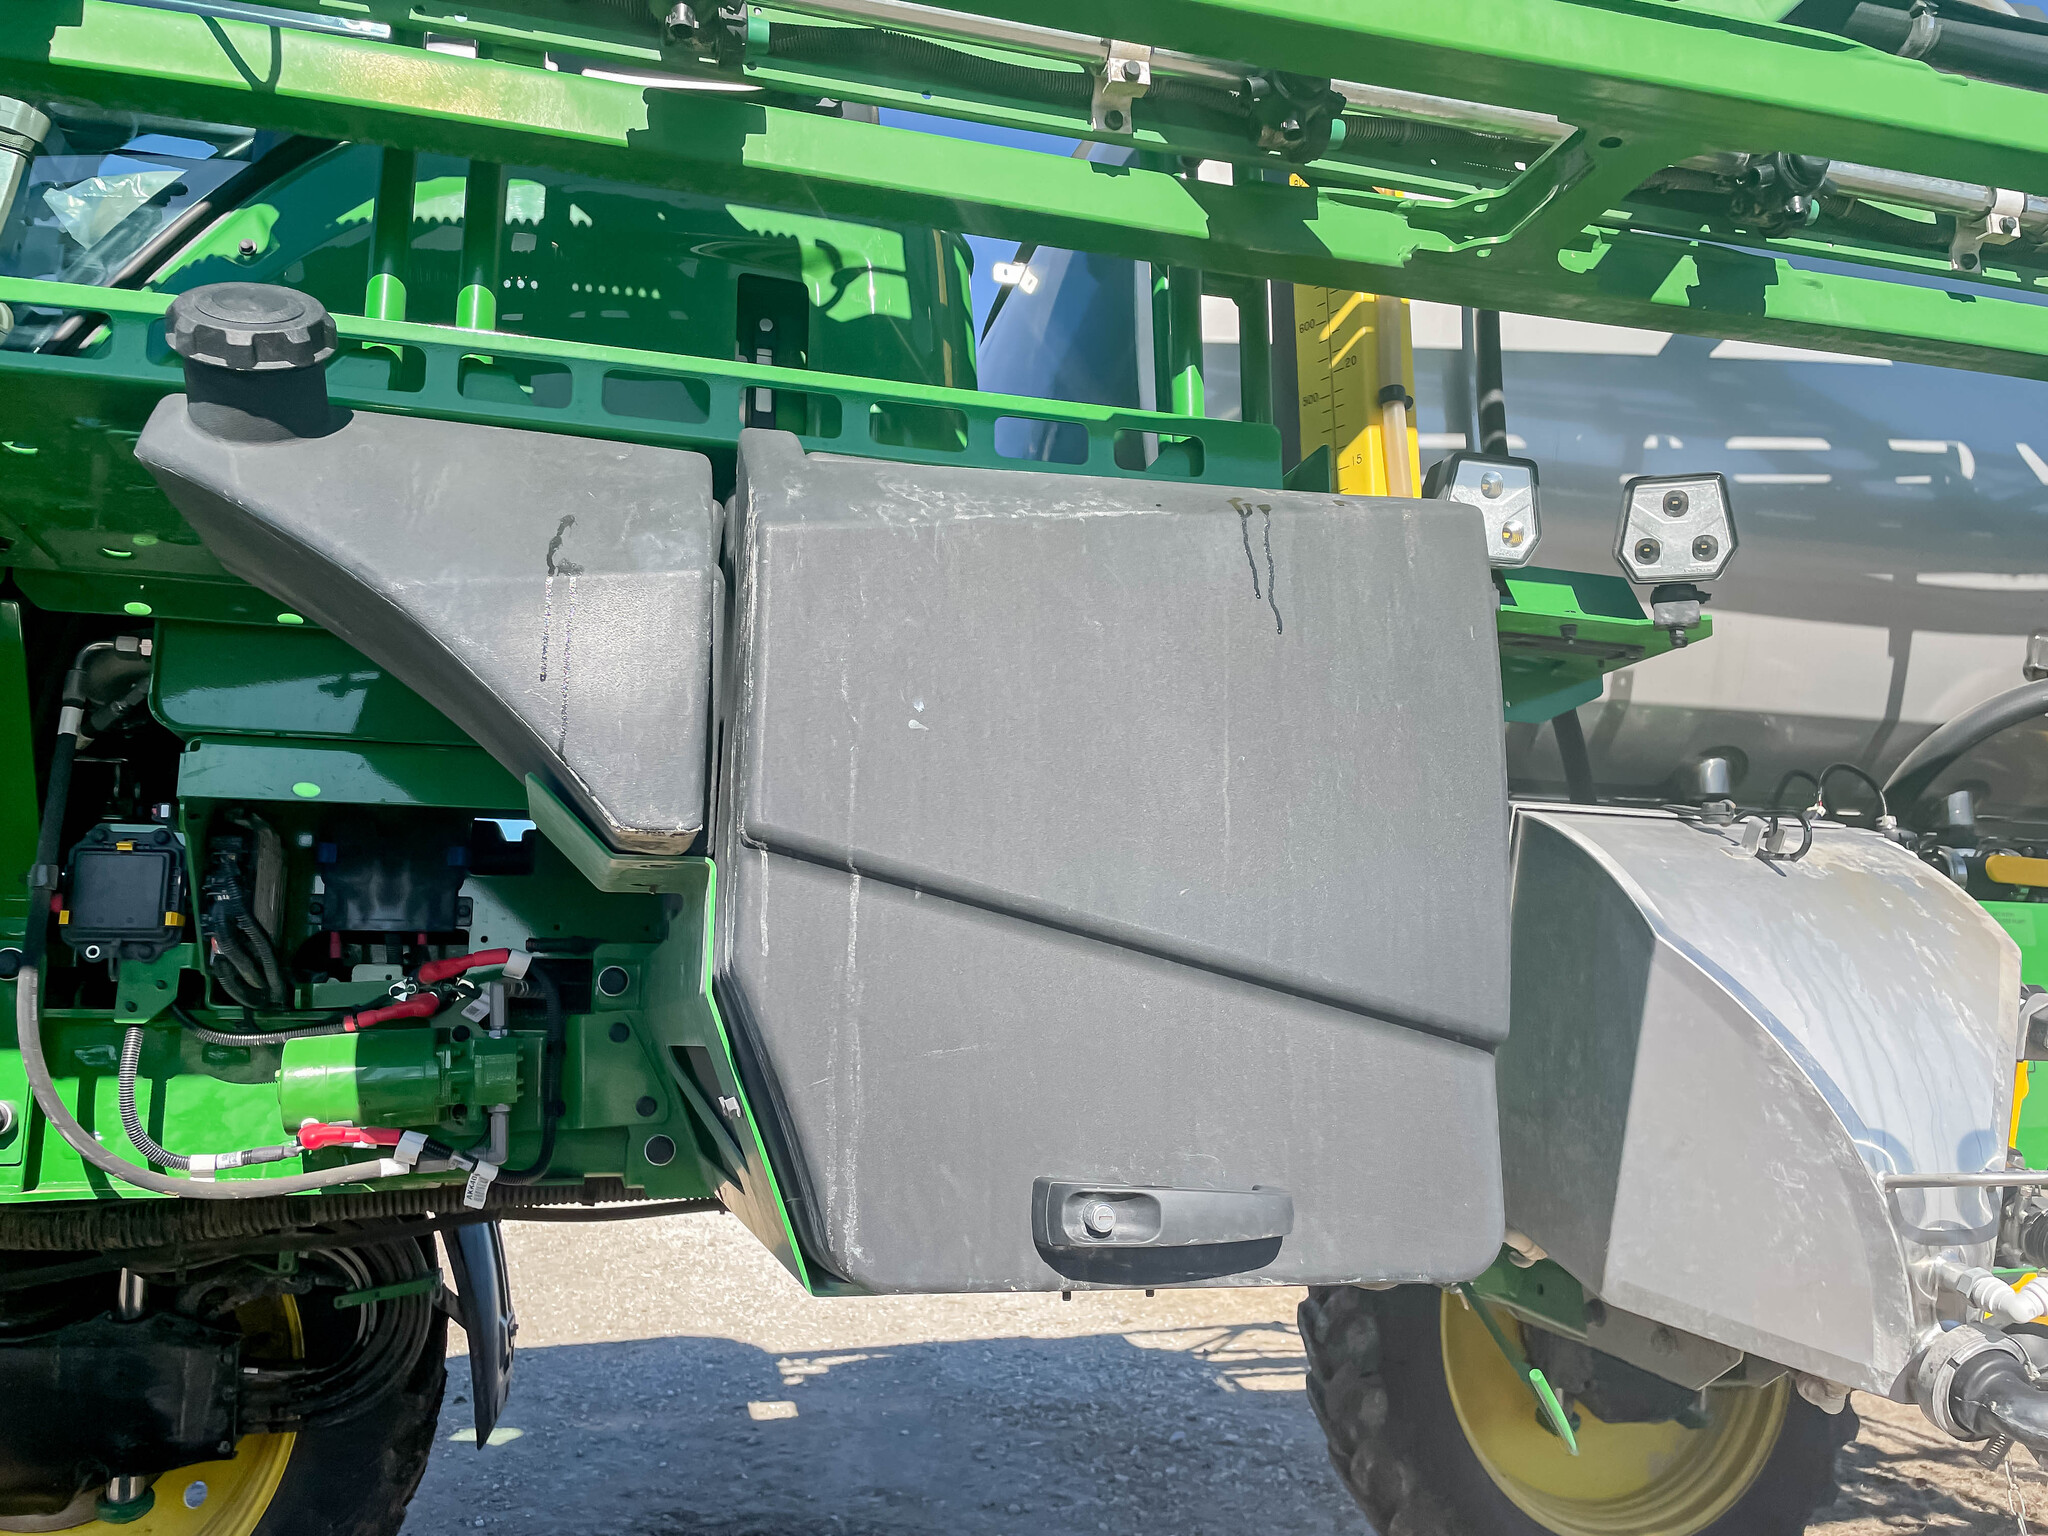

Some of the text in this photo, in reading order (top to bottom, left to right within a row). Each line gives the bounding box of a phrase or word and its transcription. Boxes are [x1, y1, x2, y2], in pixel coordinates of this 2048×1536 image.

[1299, 318, 1315, 333] 600
[1345, 355, 1357, 368] 20
[1352, 453, 1363, 466] 15
